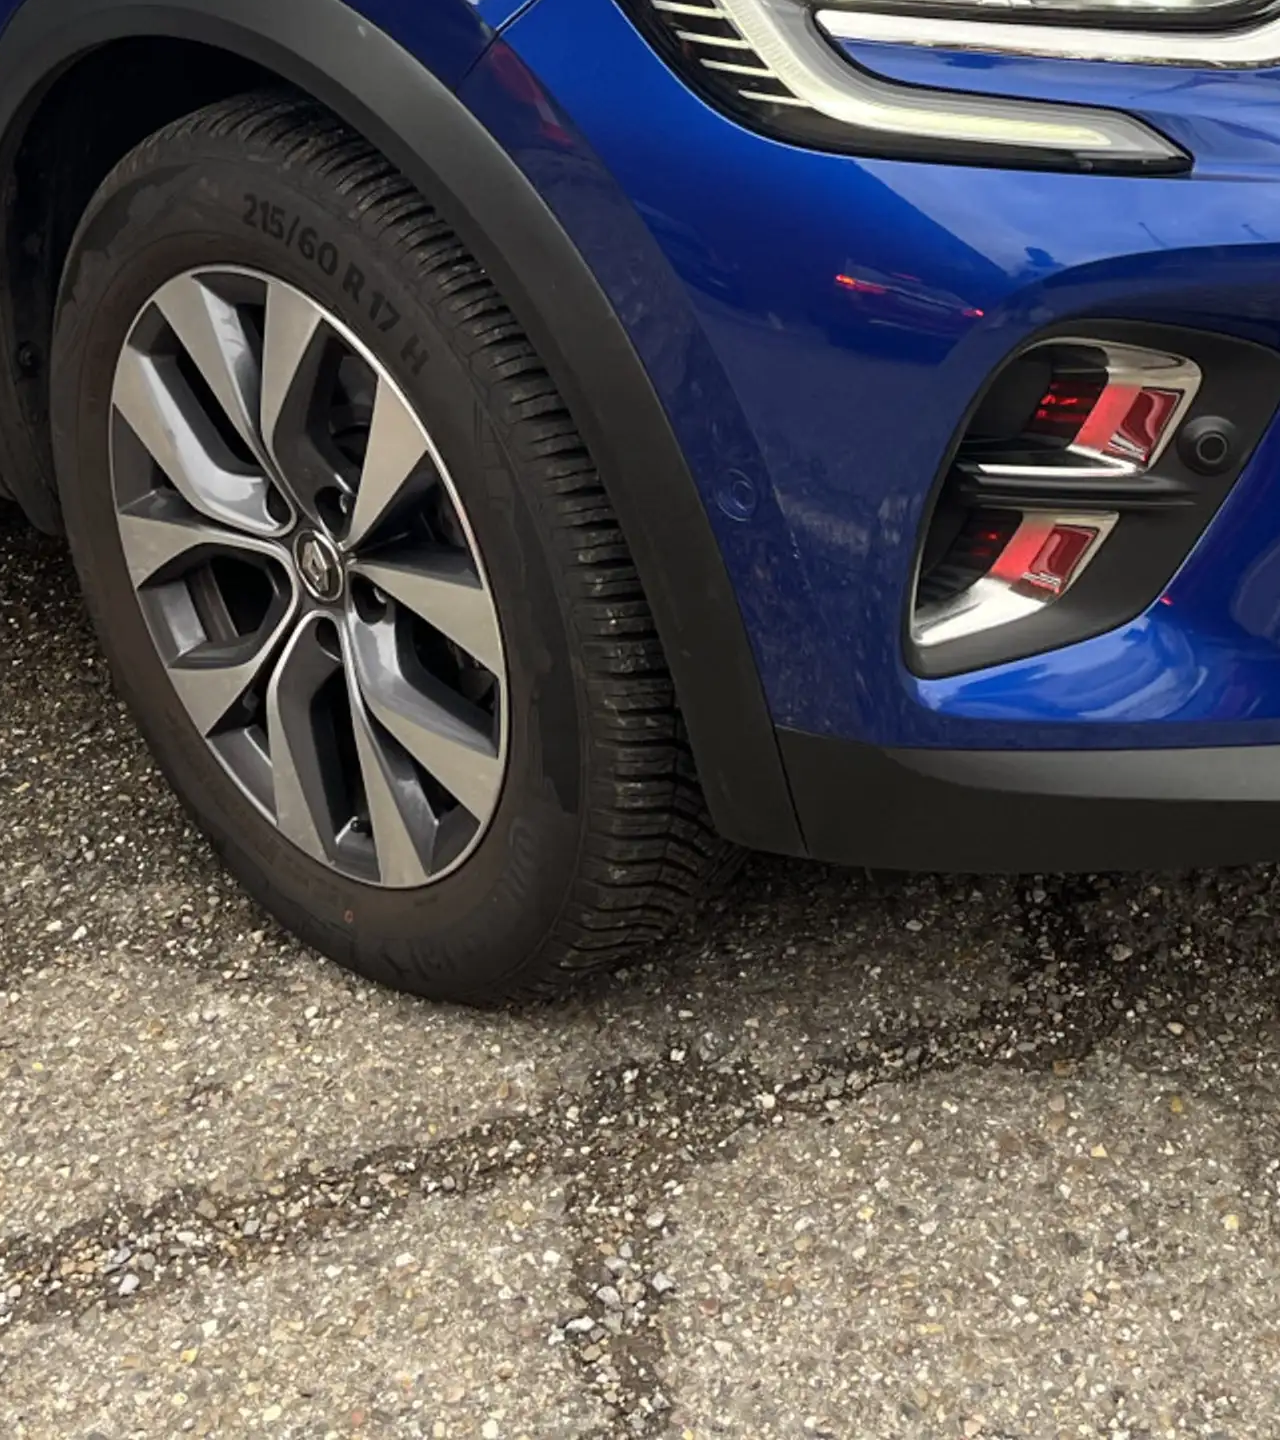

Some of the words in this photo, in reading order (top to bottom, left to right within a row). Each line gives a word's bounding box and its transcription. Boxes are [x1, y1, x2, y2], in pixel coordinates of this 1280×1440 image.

[241, 193, 338, 276] 215/60
[342, 262, 365, 304] R
[369, 292, 400, 333] 17
[400, 335, 429, 376] H
